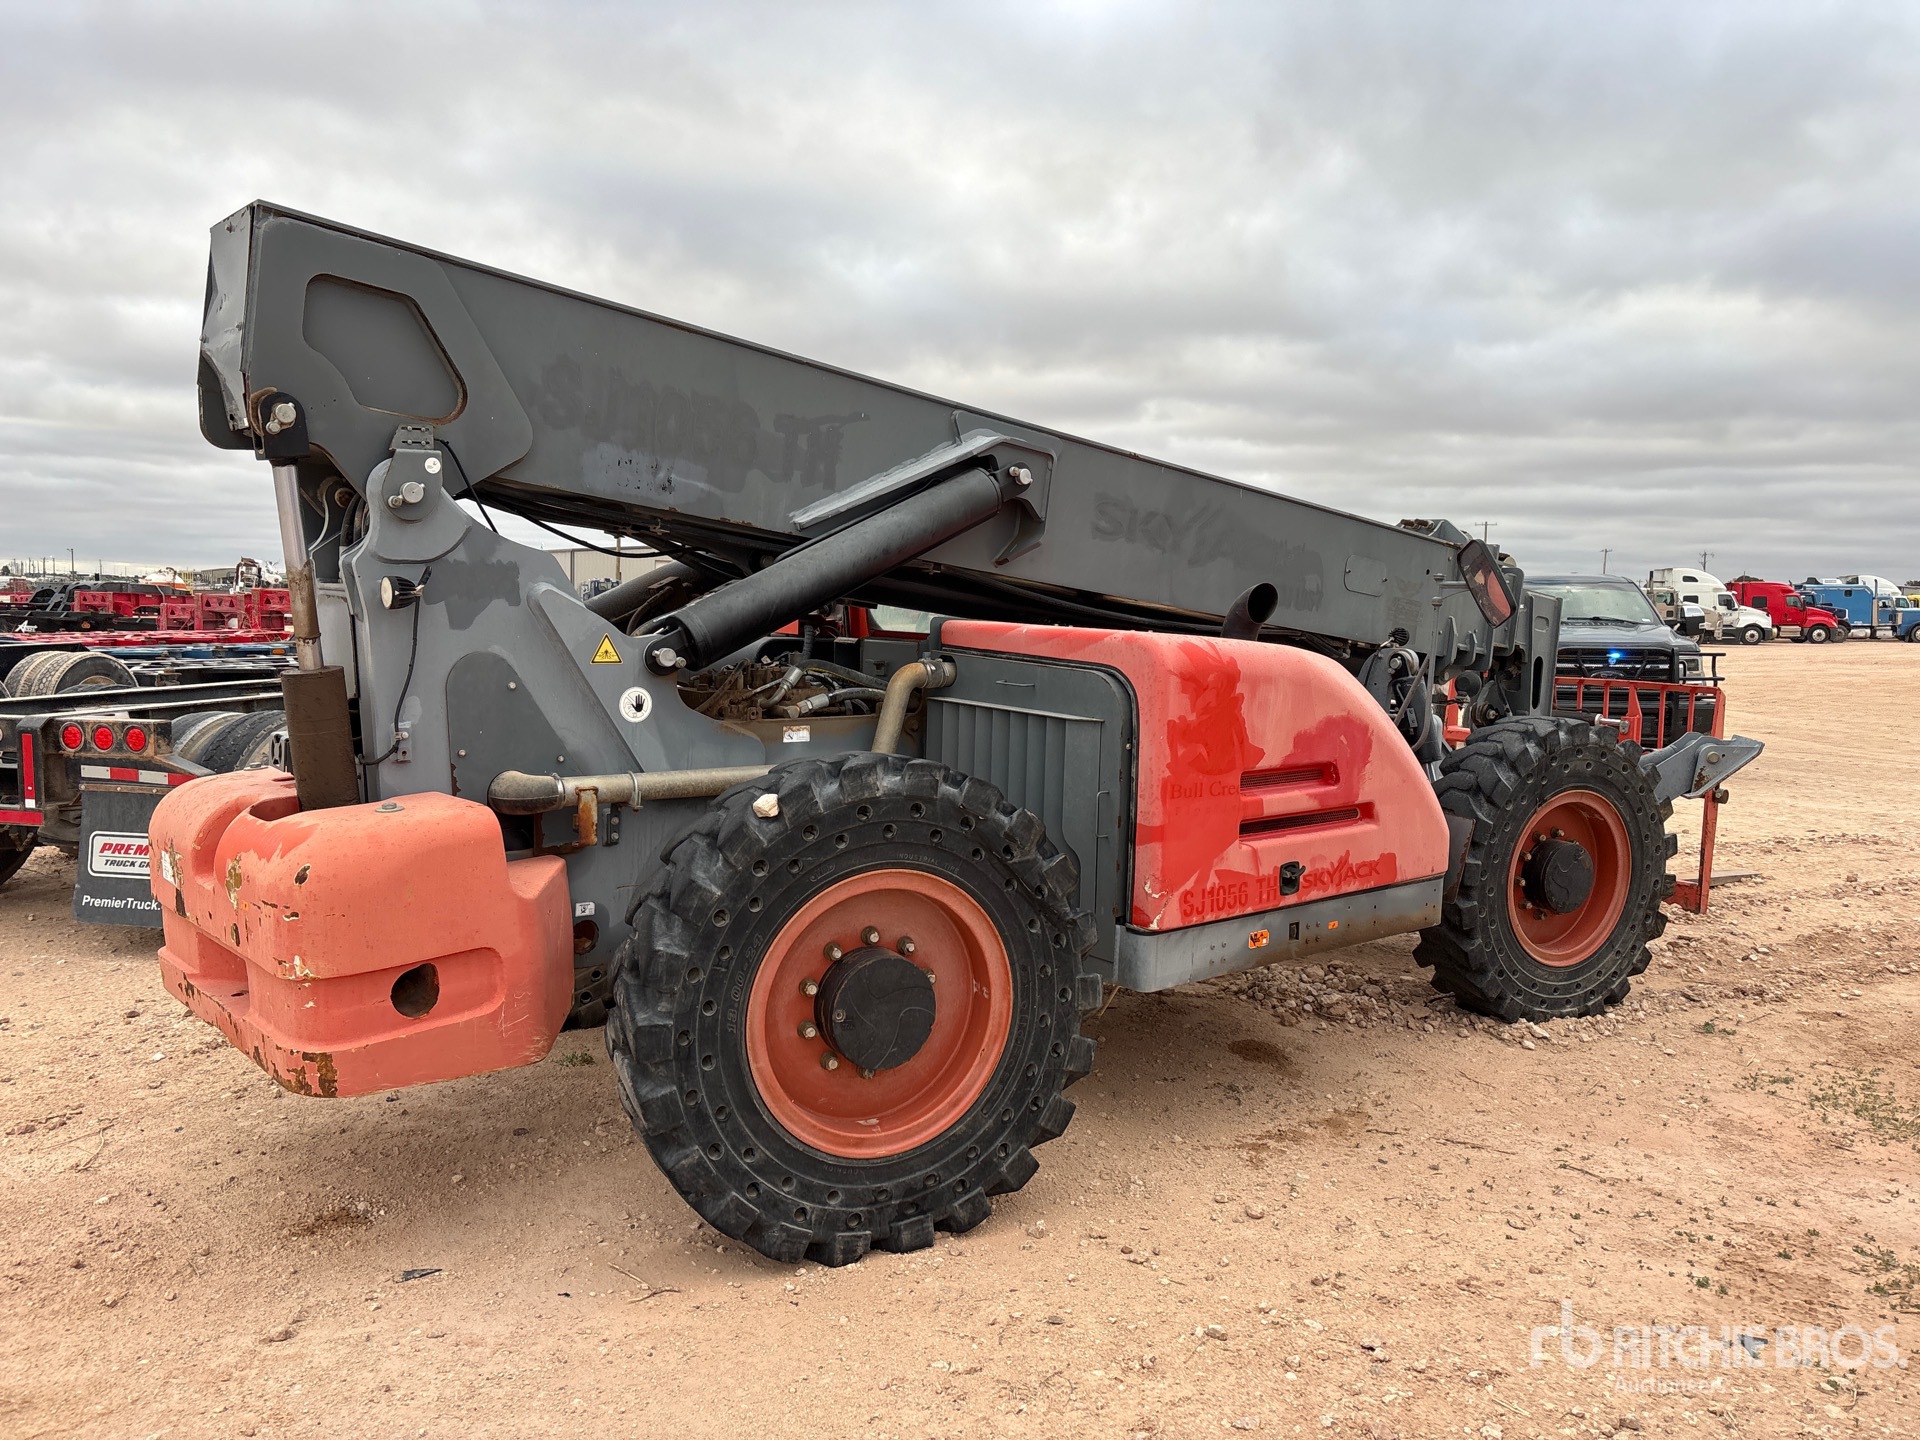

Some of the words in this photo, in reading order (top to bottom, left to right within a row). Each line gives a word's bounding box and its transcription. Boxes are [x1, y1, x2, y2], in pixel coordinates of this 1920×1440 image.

[1170, 782, 1204, 799] Bull
[99, 842, 150, 856] PREM
[104, 859, 137, 868] TRUCK
[1183, 880, 1249, 918] SJ1056
[1256, 875, 1279, 905] TH
[1302, 854, 1381, 889] SKYJACK
[82, 894, 161, 911] PremierTruck.
